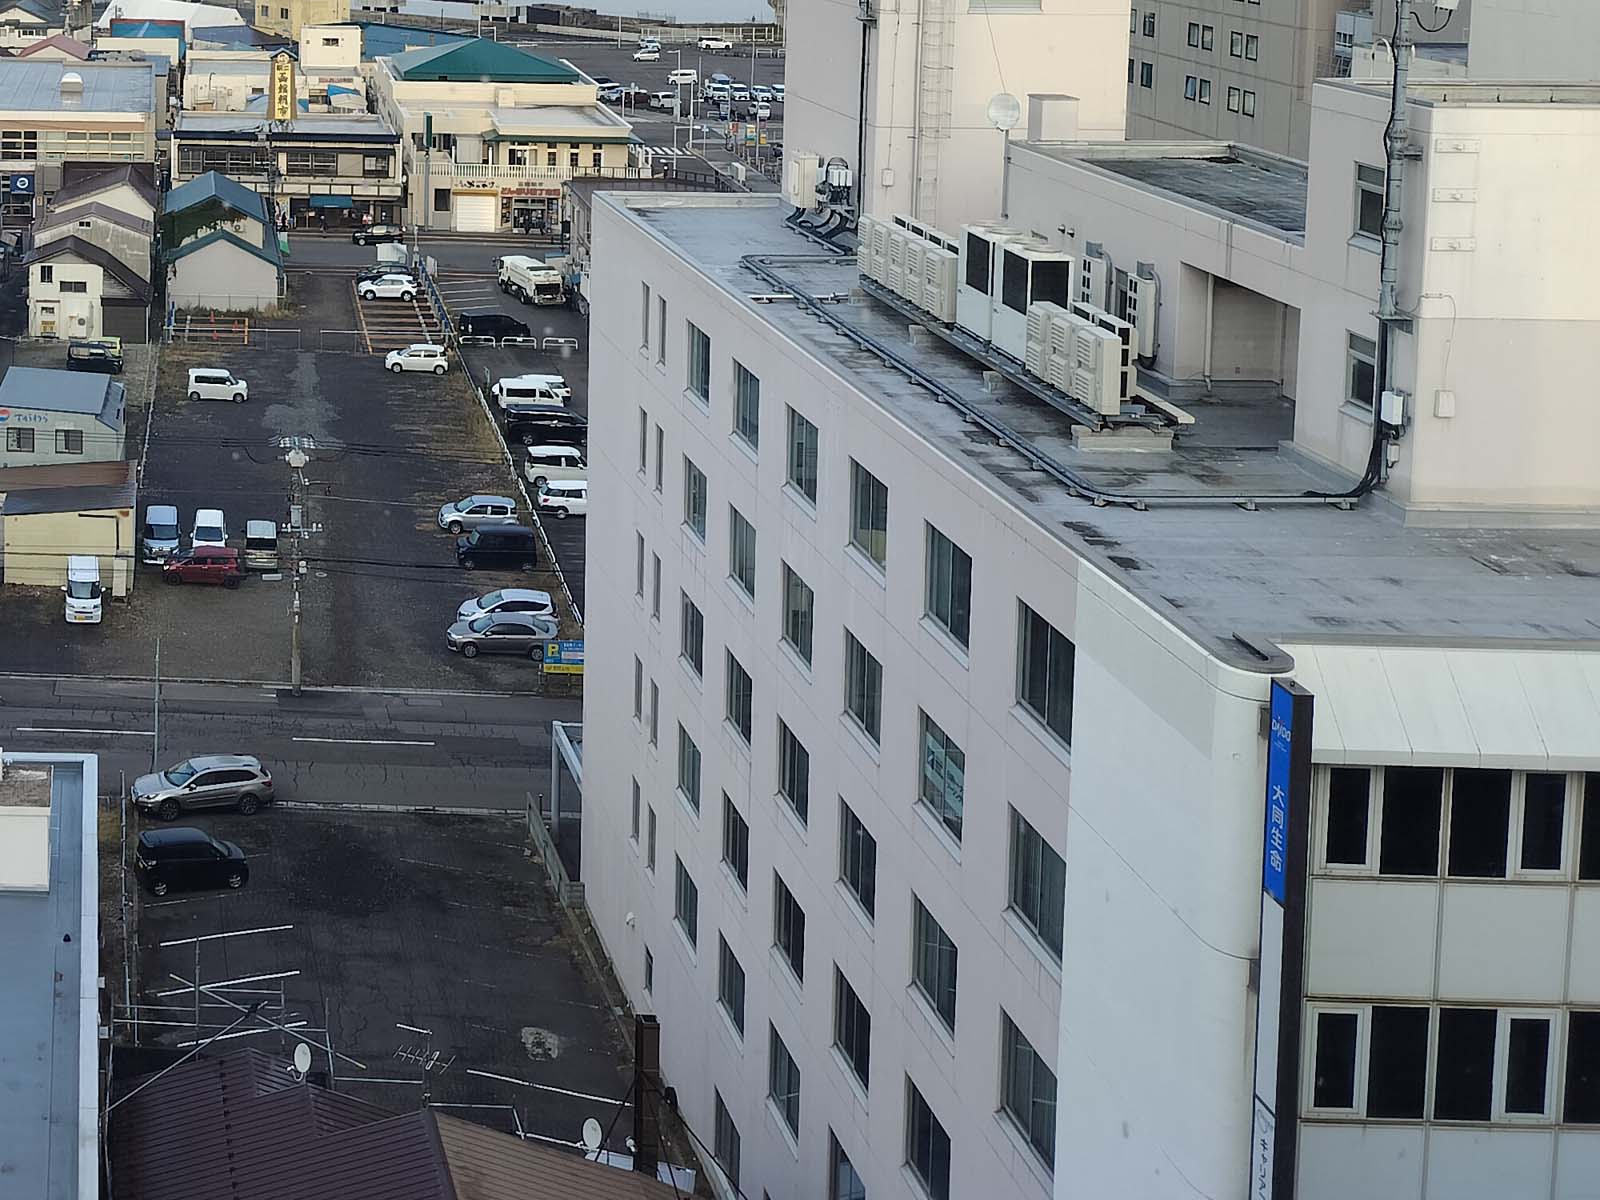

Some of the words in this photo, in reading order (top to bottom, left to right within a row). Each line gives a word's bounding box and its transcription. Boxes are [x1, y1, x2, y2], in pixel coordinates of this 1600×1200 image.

[548, 643, 559, 656] P
[1269, 784, 1285, 873] 大同生命
